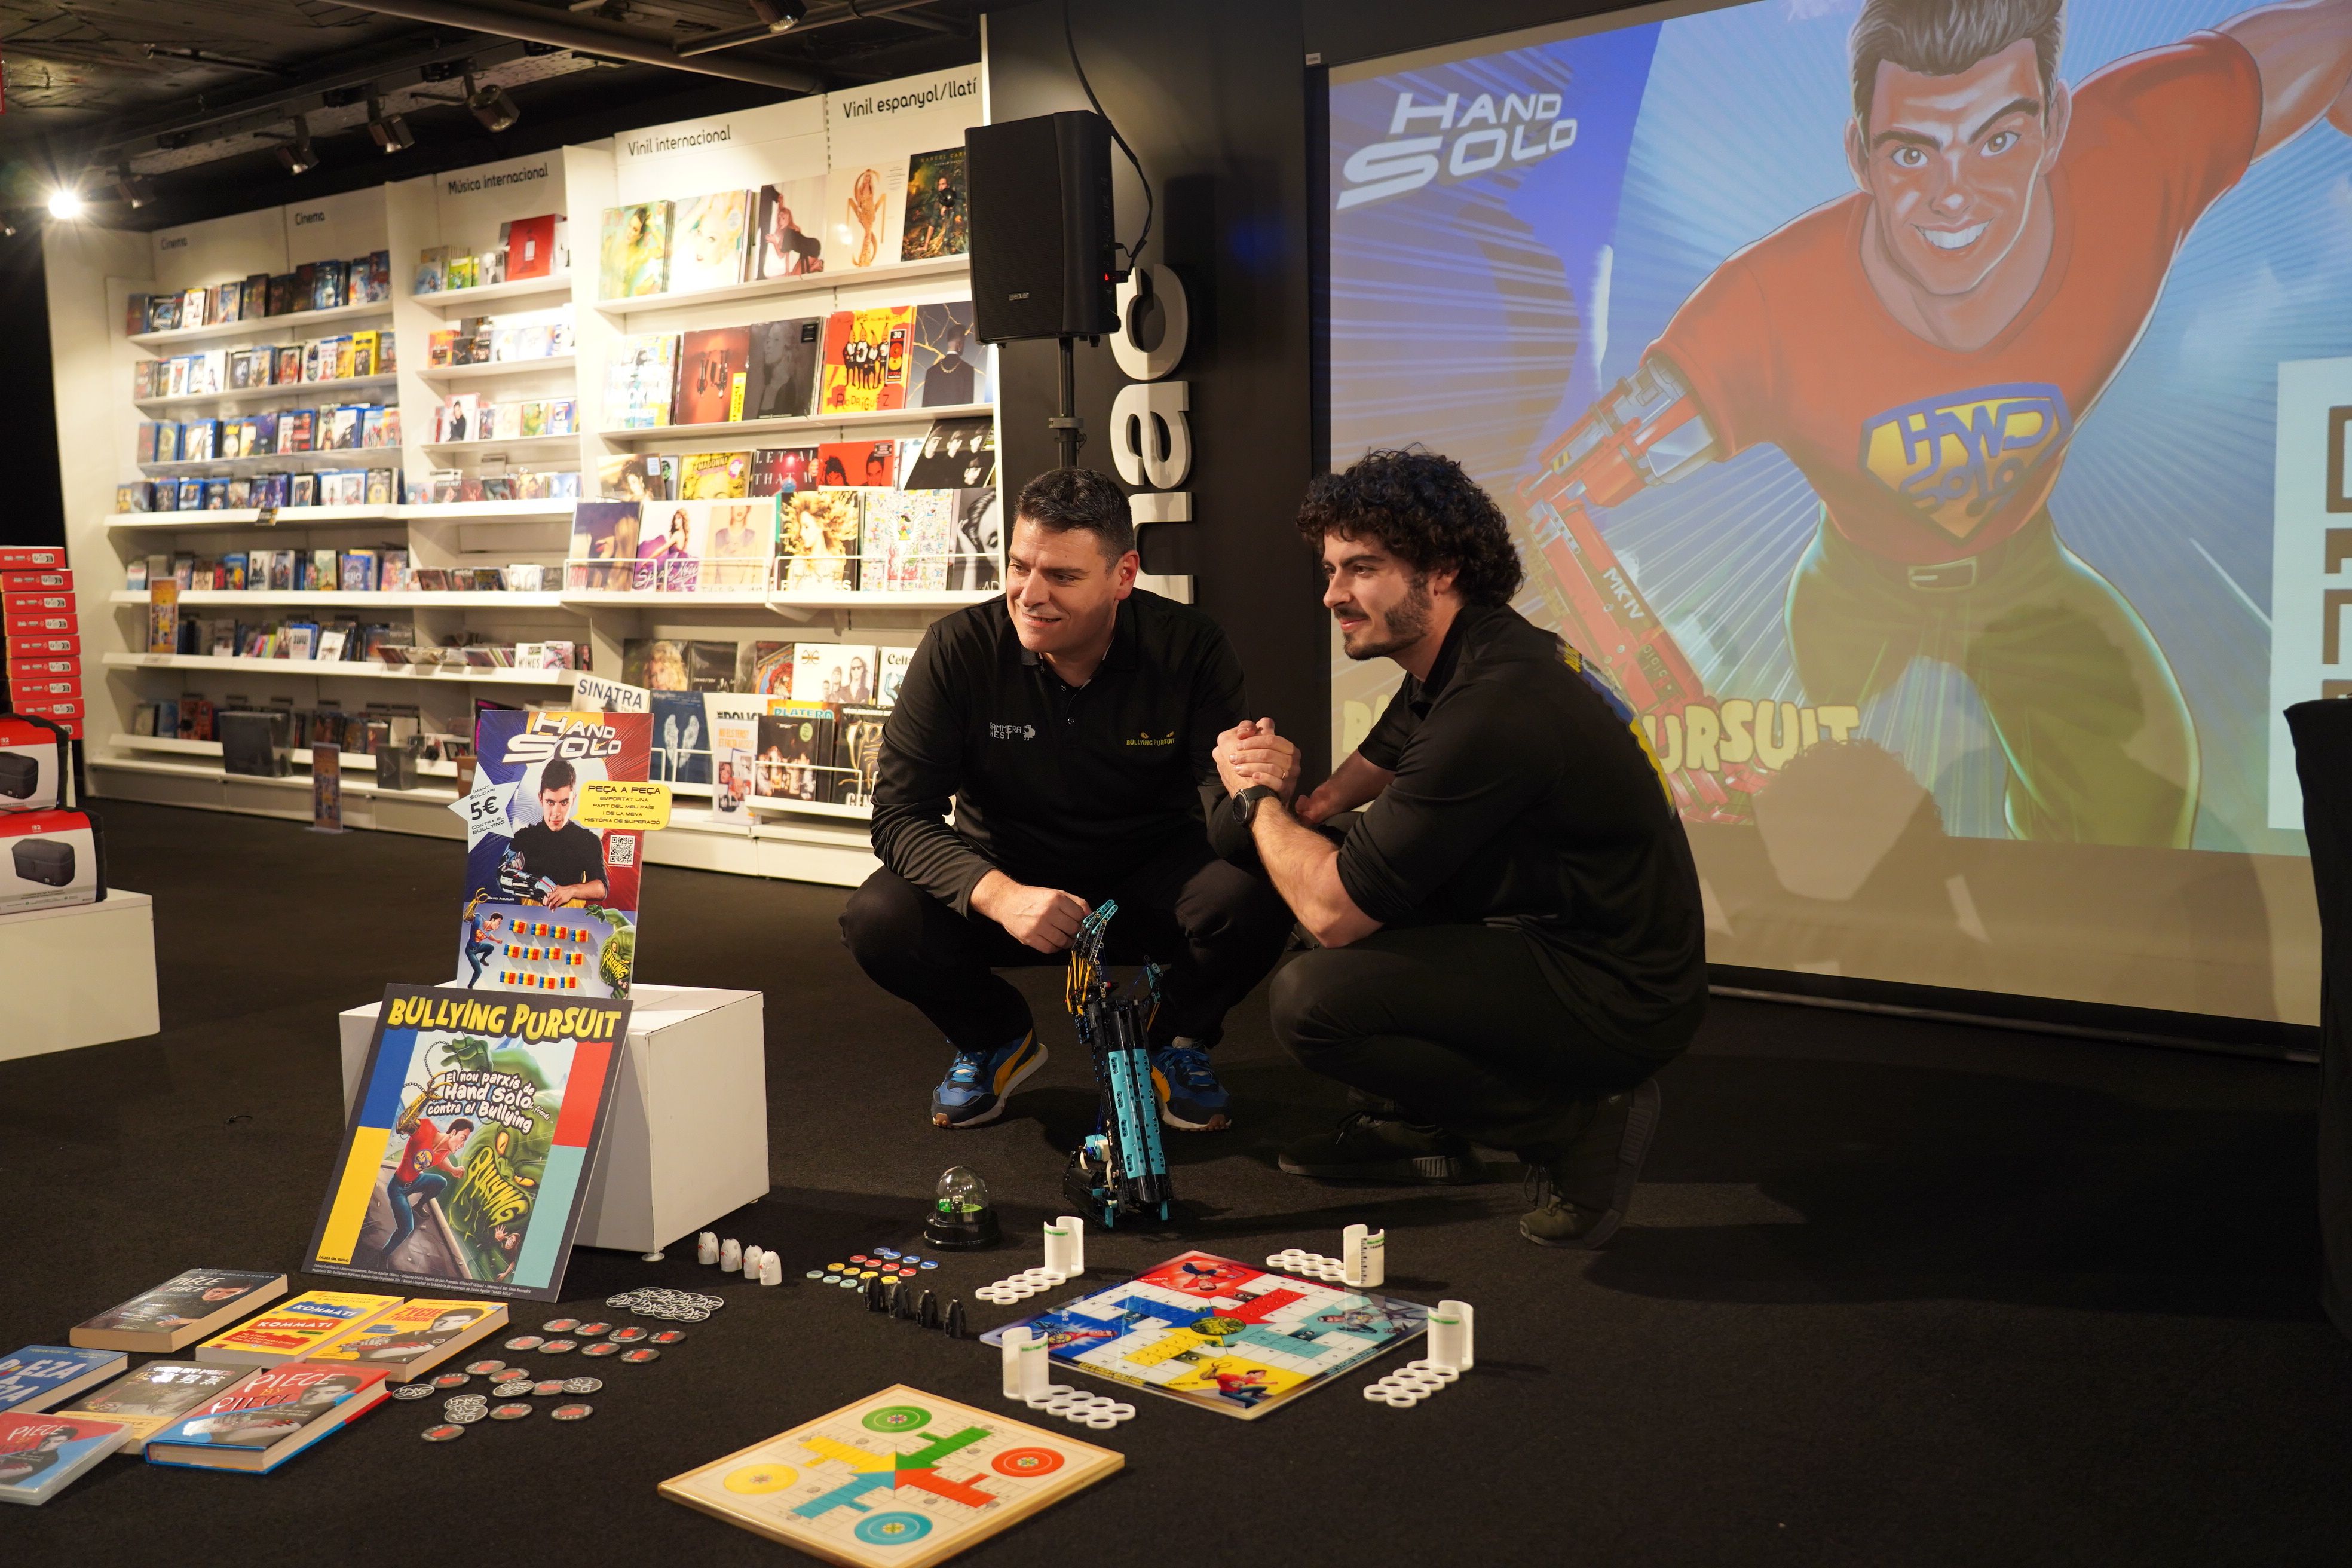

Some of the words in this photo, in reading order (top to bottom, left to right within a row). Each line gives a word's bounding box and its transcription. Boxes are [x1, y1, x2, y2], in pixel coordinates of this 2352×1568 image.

[843, 98, 874, 118] Vinil
[877, 77, 978, 114] espanyol/llatí
[1389, 93, 1562, 134] HAND
[629, 138, 653, 157] Vinil
[656, 125, 731, 152] internacional
[1336, 118, 1578, 210] SOLO
[448, 179, 481, 195] Música
[483, 163, 548, 189] internacional
[295, 212, 325, 225] Cinema
[161, 237, 188, 250] Cinema
[697, 457, 729, 471] MADONNA
[578, 679, 642, 709] SINATRA
[532, 712, 615, 739] HAND
[990, 722, 1022, 733] GAMMERA
[990, 730, 1012, 740] NEST
[1642, 699, 1860, 774] URSUIT
[502, 734, 622, 764] SOLO
[470, 788, 495, 800] SOLIDARI
[473, 785, 489, 794] IMANT
[588, 785, 617, 794] PEÇA
[631, 787, 661, 795] PEÇA
[471, 796, 499, 820] 5€
[472, 820, 494, 830] CONTRA
[473, 821, 505, 835] BULLYING
[387, 996, 507, 1034] BULLYING
[510, 1003, 622, 1040] PURSUIT
[446, 1072, 454, 1082] El
[460, 1071, 479, 1082] nou
[482, 1072, 520, 1089] parxís
[523, 1082, 535, 1095] de
[445, 1082, 488, 1101] Hand
[492, 1086, 532, 1109] Solo
[534, 1105, 550, 1120] friends
[428, 1102, 461, 1115] contra
[465, 1104, 475, 1114] el
[478, 1102, 533, 1132] Bullying
[245, 1373, 346, 1392] PIECE
[7, 1425, 71, 1441] PIECE
